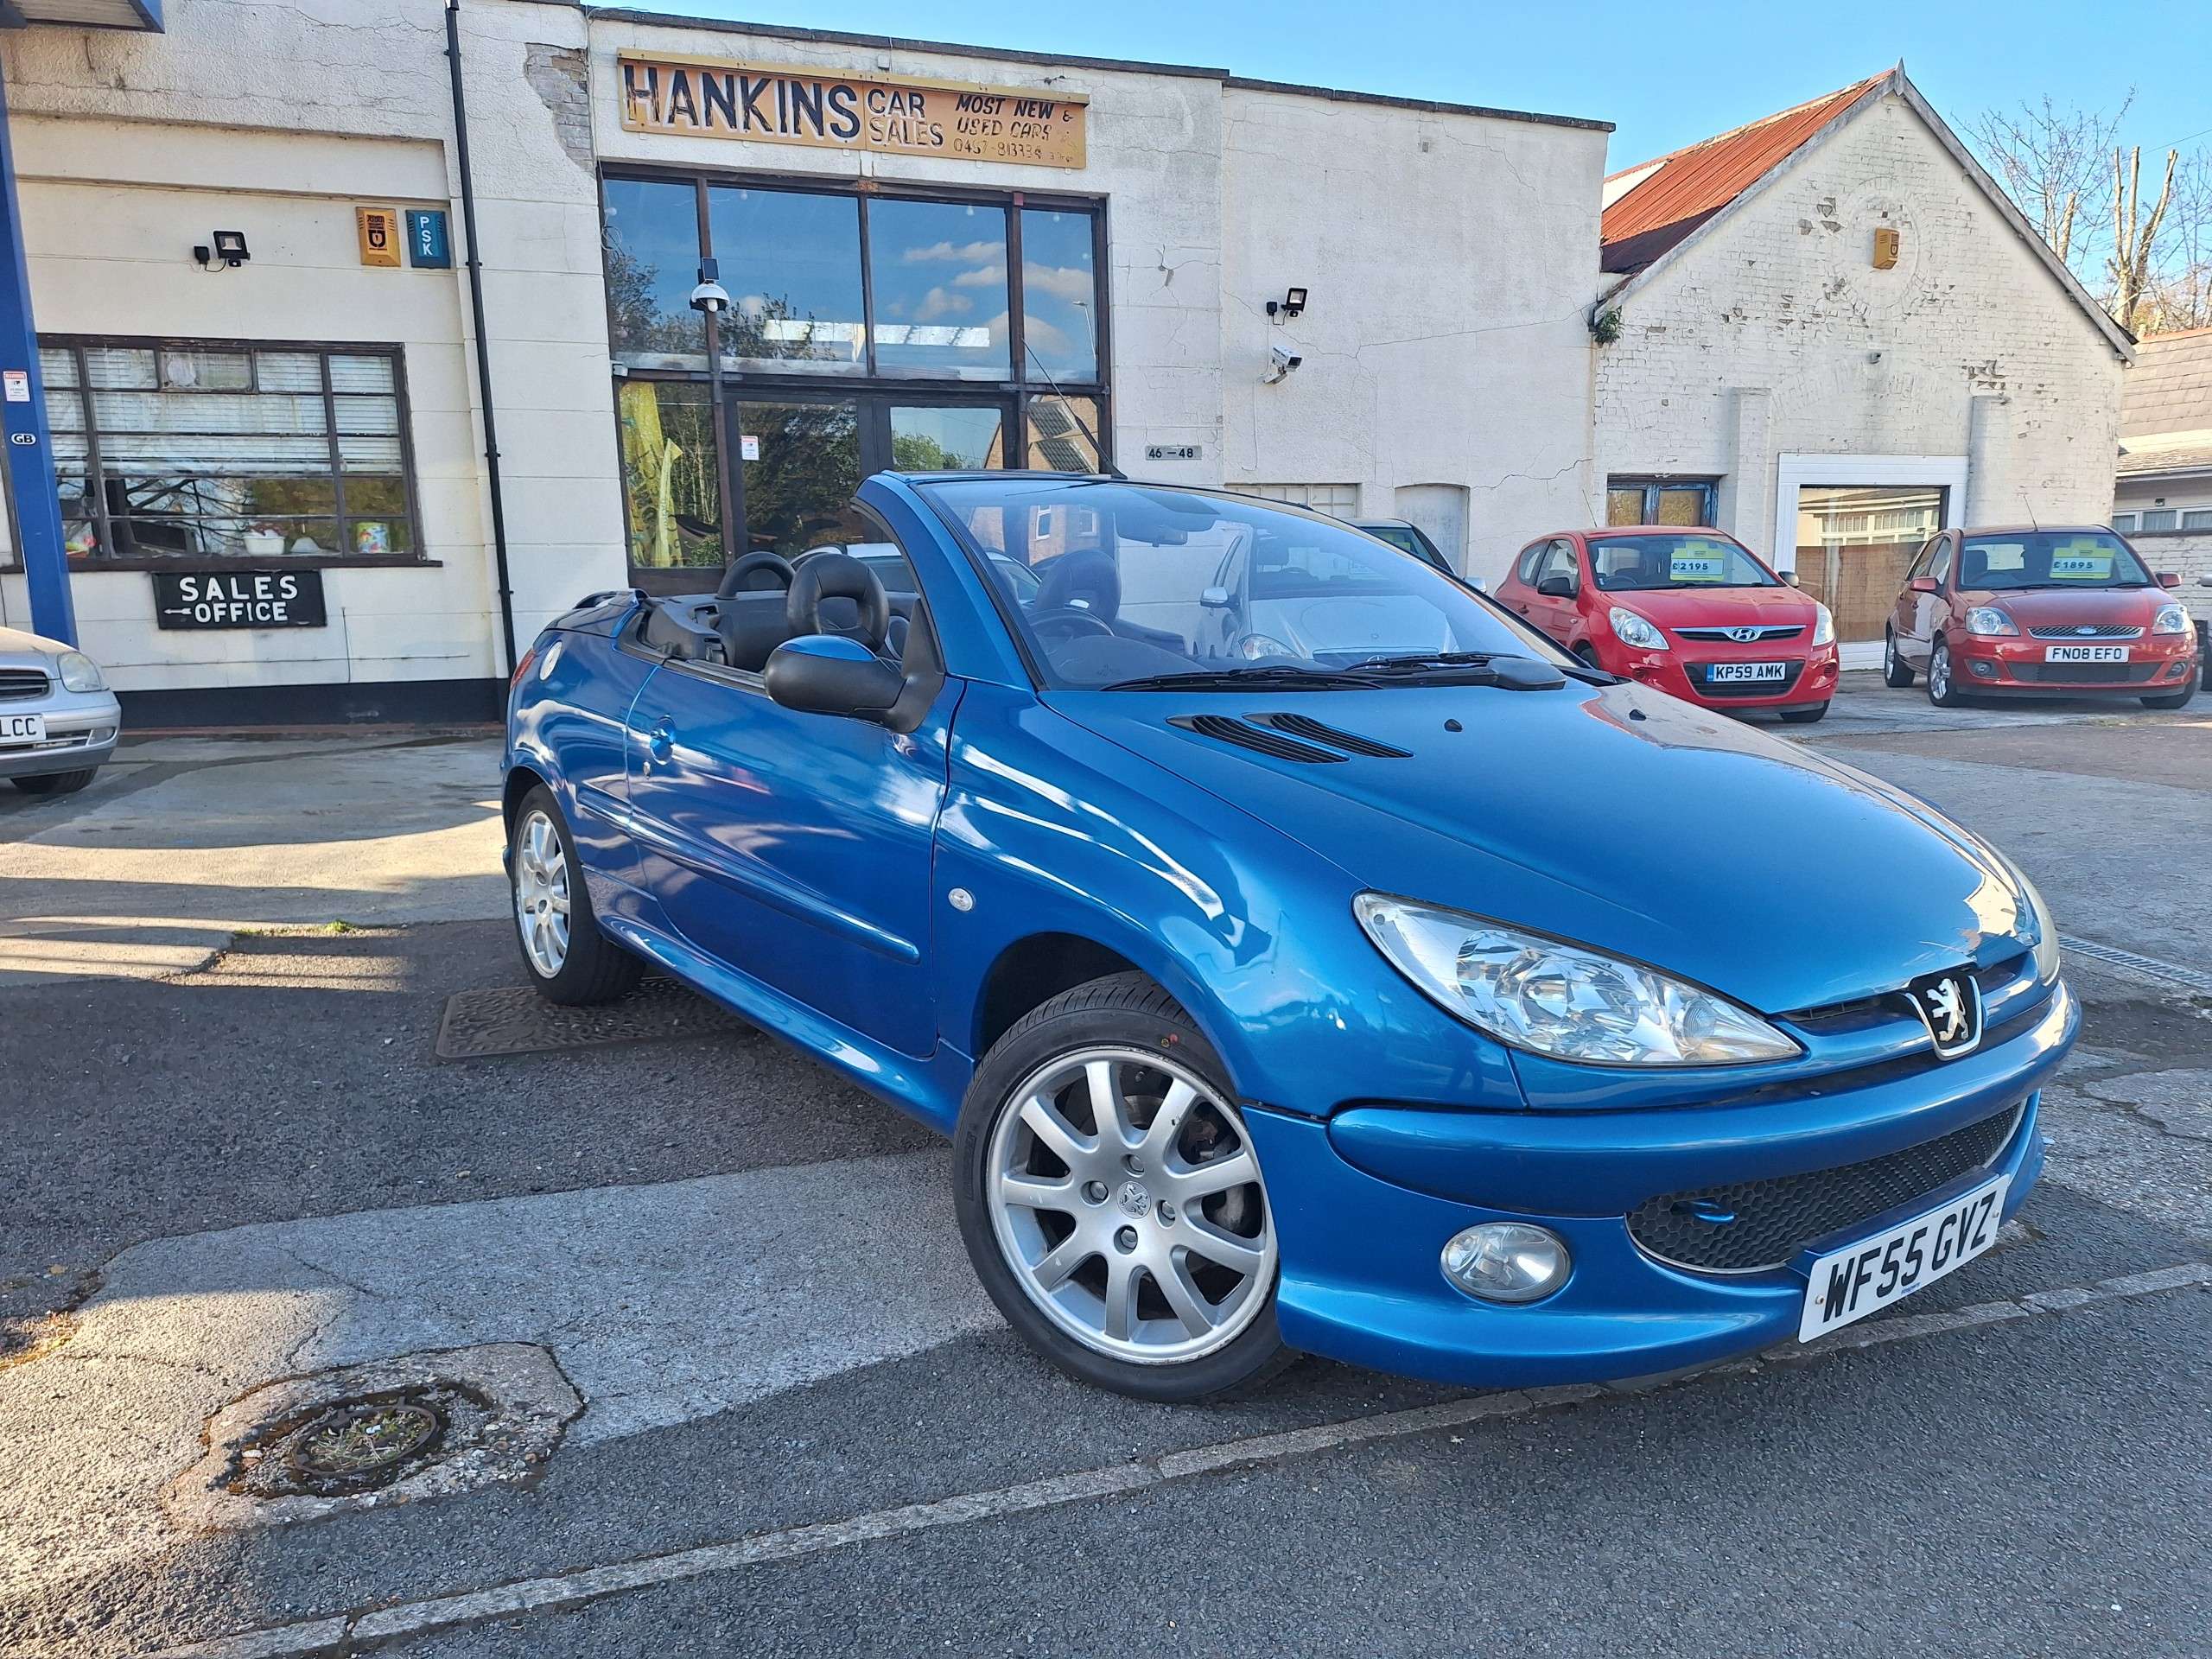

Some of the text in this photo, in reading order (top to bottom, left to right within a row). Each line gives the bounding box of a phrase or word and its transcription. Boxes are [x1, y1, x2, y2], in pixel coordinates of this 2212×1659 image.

[623, 64, 861, 138] HANKINS
[867, 88, 926, 118] CAR
[955, 94, 1074, 123] MOST NEW &
[868, 117, 944, 147] SALES
[957, 117, 1052, 142] USED CARS
[419, 215, 433, 256] PSK
[13, 434, 34, 443] GB
[1672, 562, 1709, 571] £2195
[2053, 561, 2094, 569] £1895
[179, 575, 298, 602] SALES
[194, 601, 289, 624] OFFICE
[2051, 647, 2123, 660] FN08 EFO
[1715, 664, 1783, 679] KP59 AMK
[1822, 1190, 1998, 1324] WF55 GVZ
